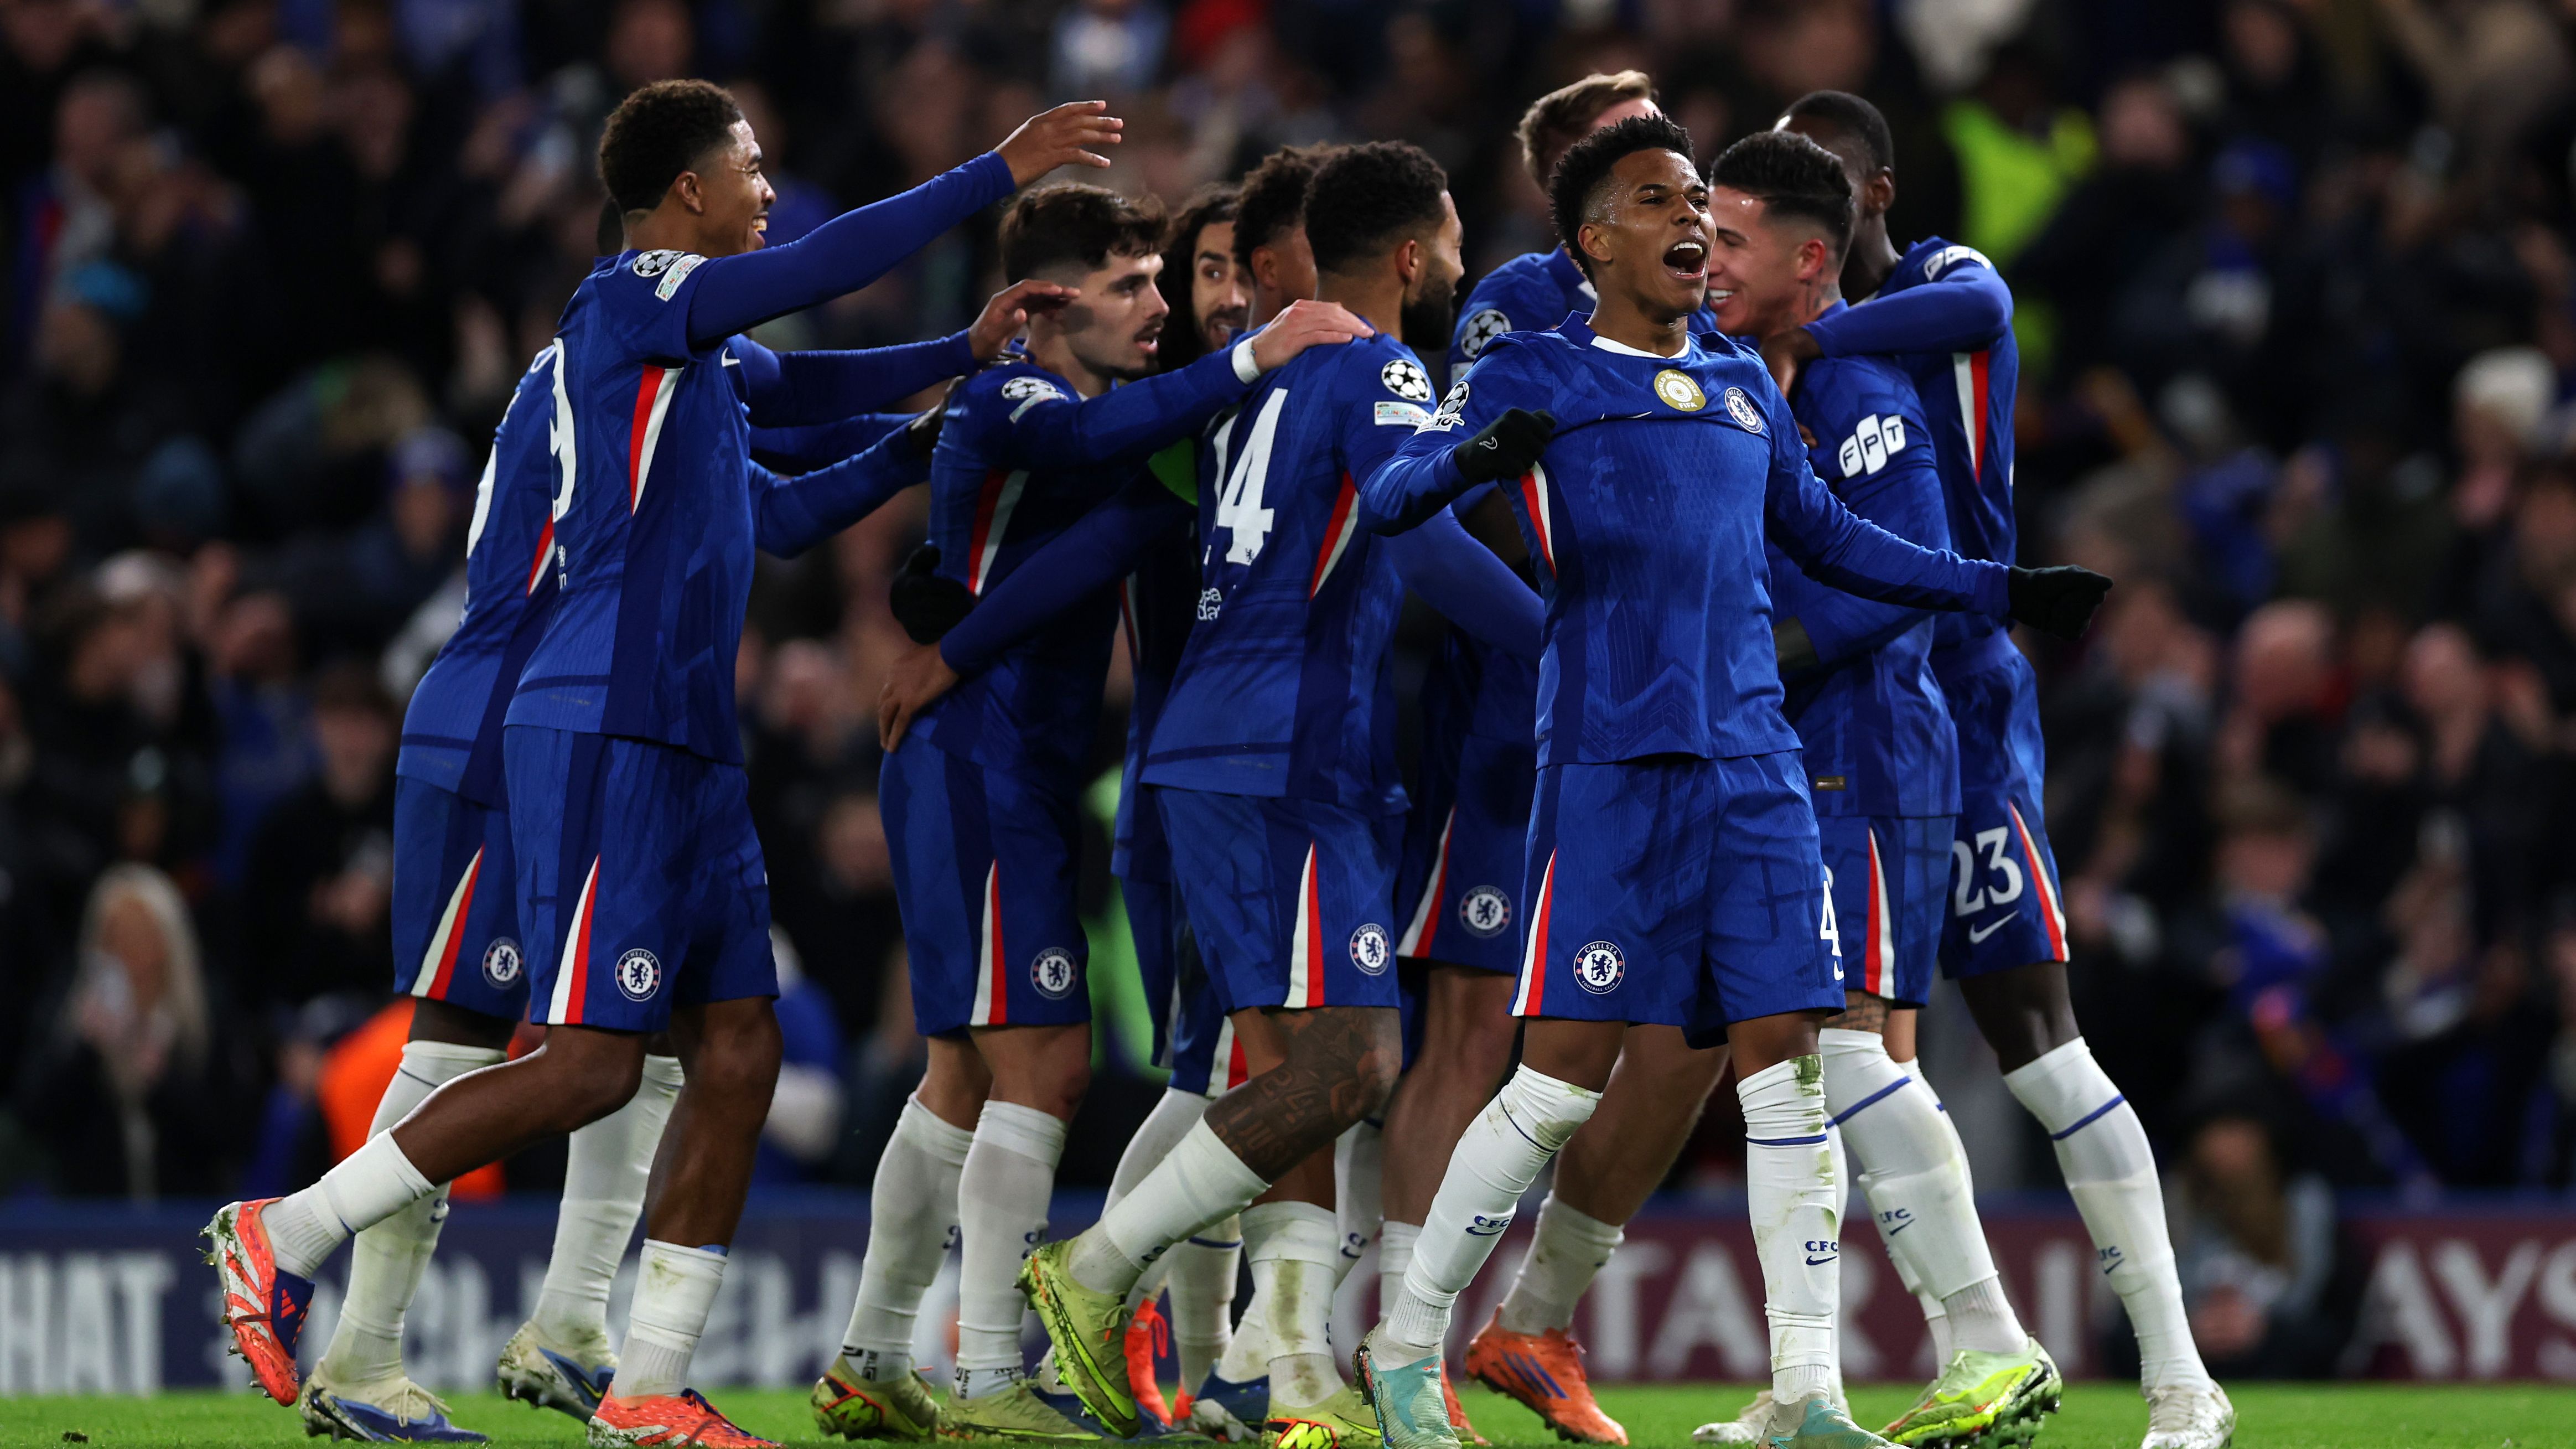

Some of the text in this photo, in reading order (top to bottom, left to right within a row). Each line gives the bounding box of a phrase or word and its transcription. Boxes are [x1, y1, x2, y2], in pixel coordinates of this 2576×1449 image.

[1658, 372, 1699, 398] WORLD CHAMPIONS
[1727, 389, 1745, 401] CHELSEA
[1842, 423, 1900, 468] FPT
[1952, 826, 2024, 917] 23
[1584, 943, 1618, 956] CHELSEA
[625, 951, 654, 964] CHELSEA
[1582, 980, 1615, 991] FOOTBALL CLUB
[1474, 1215, 1510, 1228] CFC
[1805, 1240, 1838, 1253] CFC
